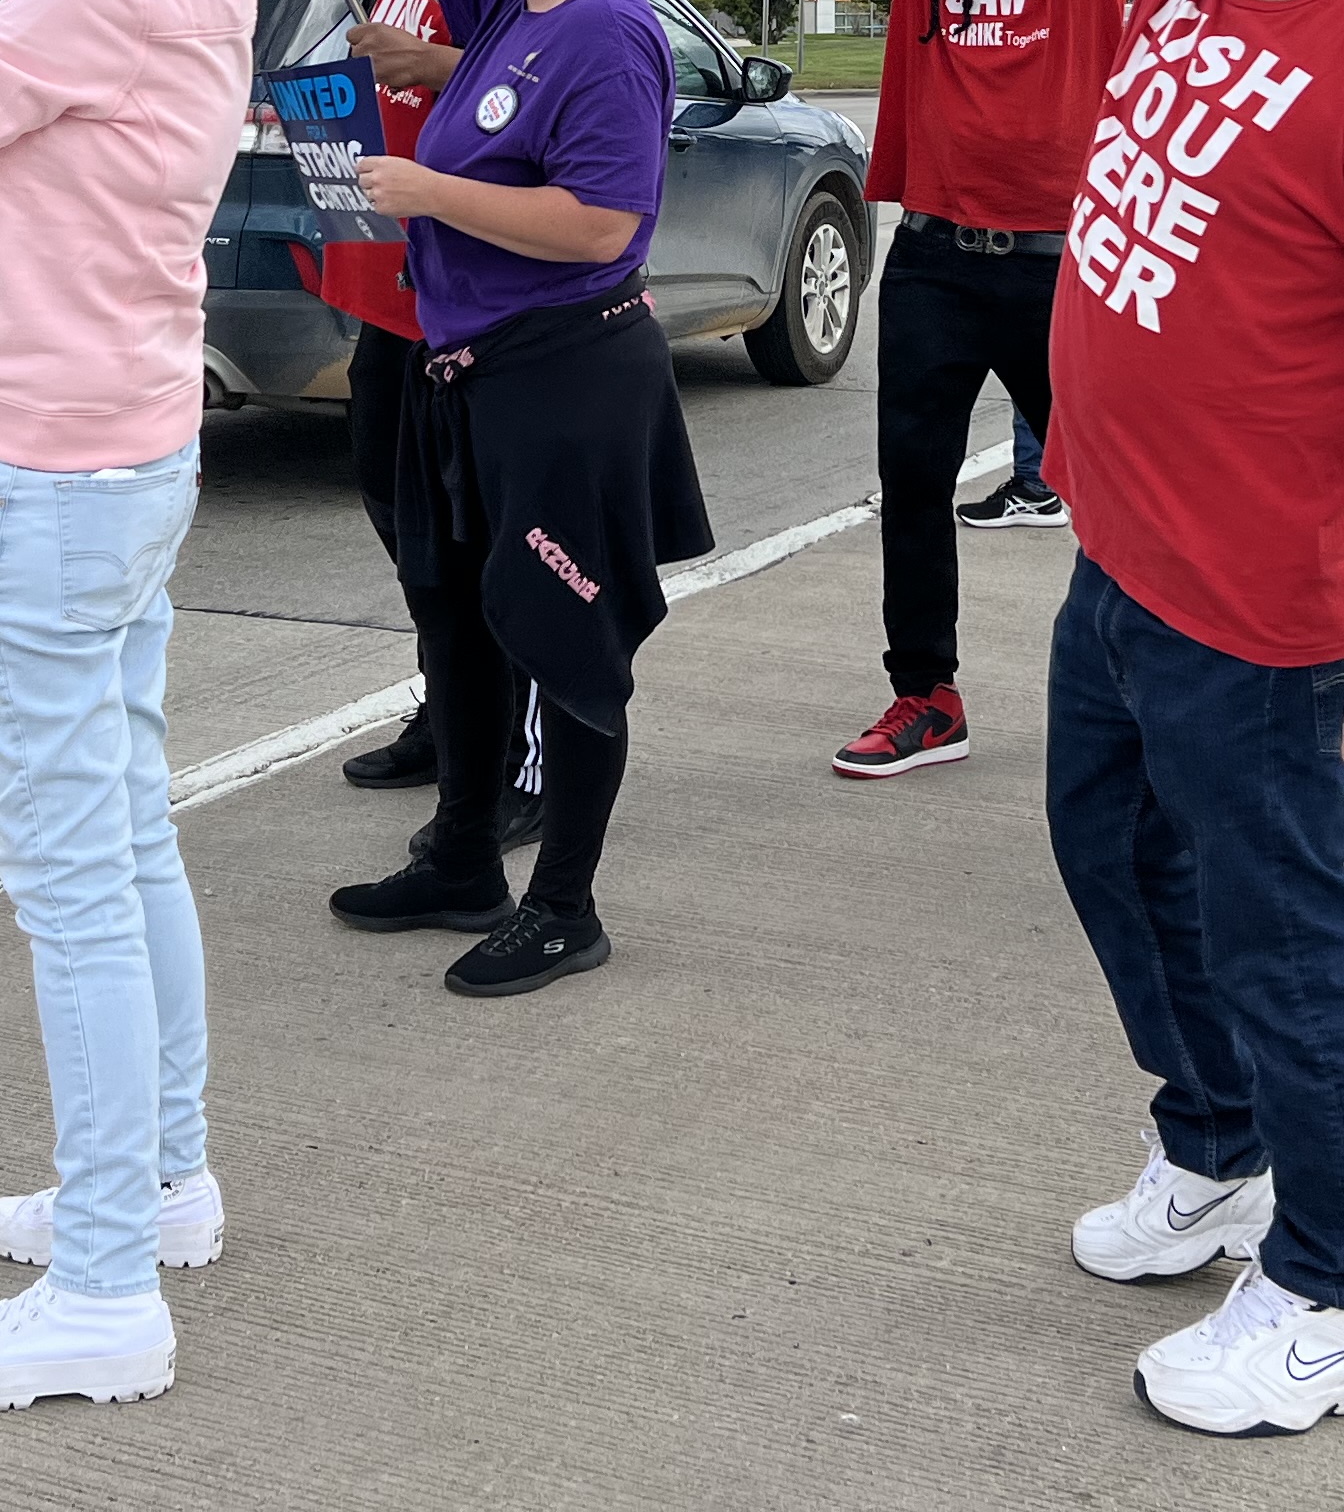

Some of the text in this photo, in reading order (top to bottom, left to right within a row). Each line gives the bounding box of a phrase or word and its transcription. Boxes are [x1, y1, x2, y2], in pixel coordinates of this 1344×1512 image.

[948, 22, 1004, 46] STRIKE
[268, 73, 356, 122] UNITED
[1105, 33, 1244, 178] YOU
[291, 139, 365, 179] STRONG
[309, 182, 376, 212] CONTRA
